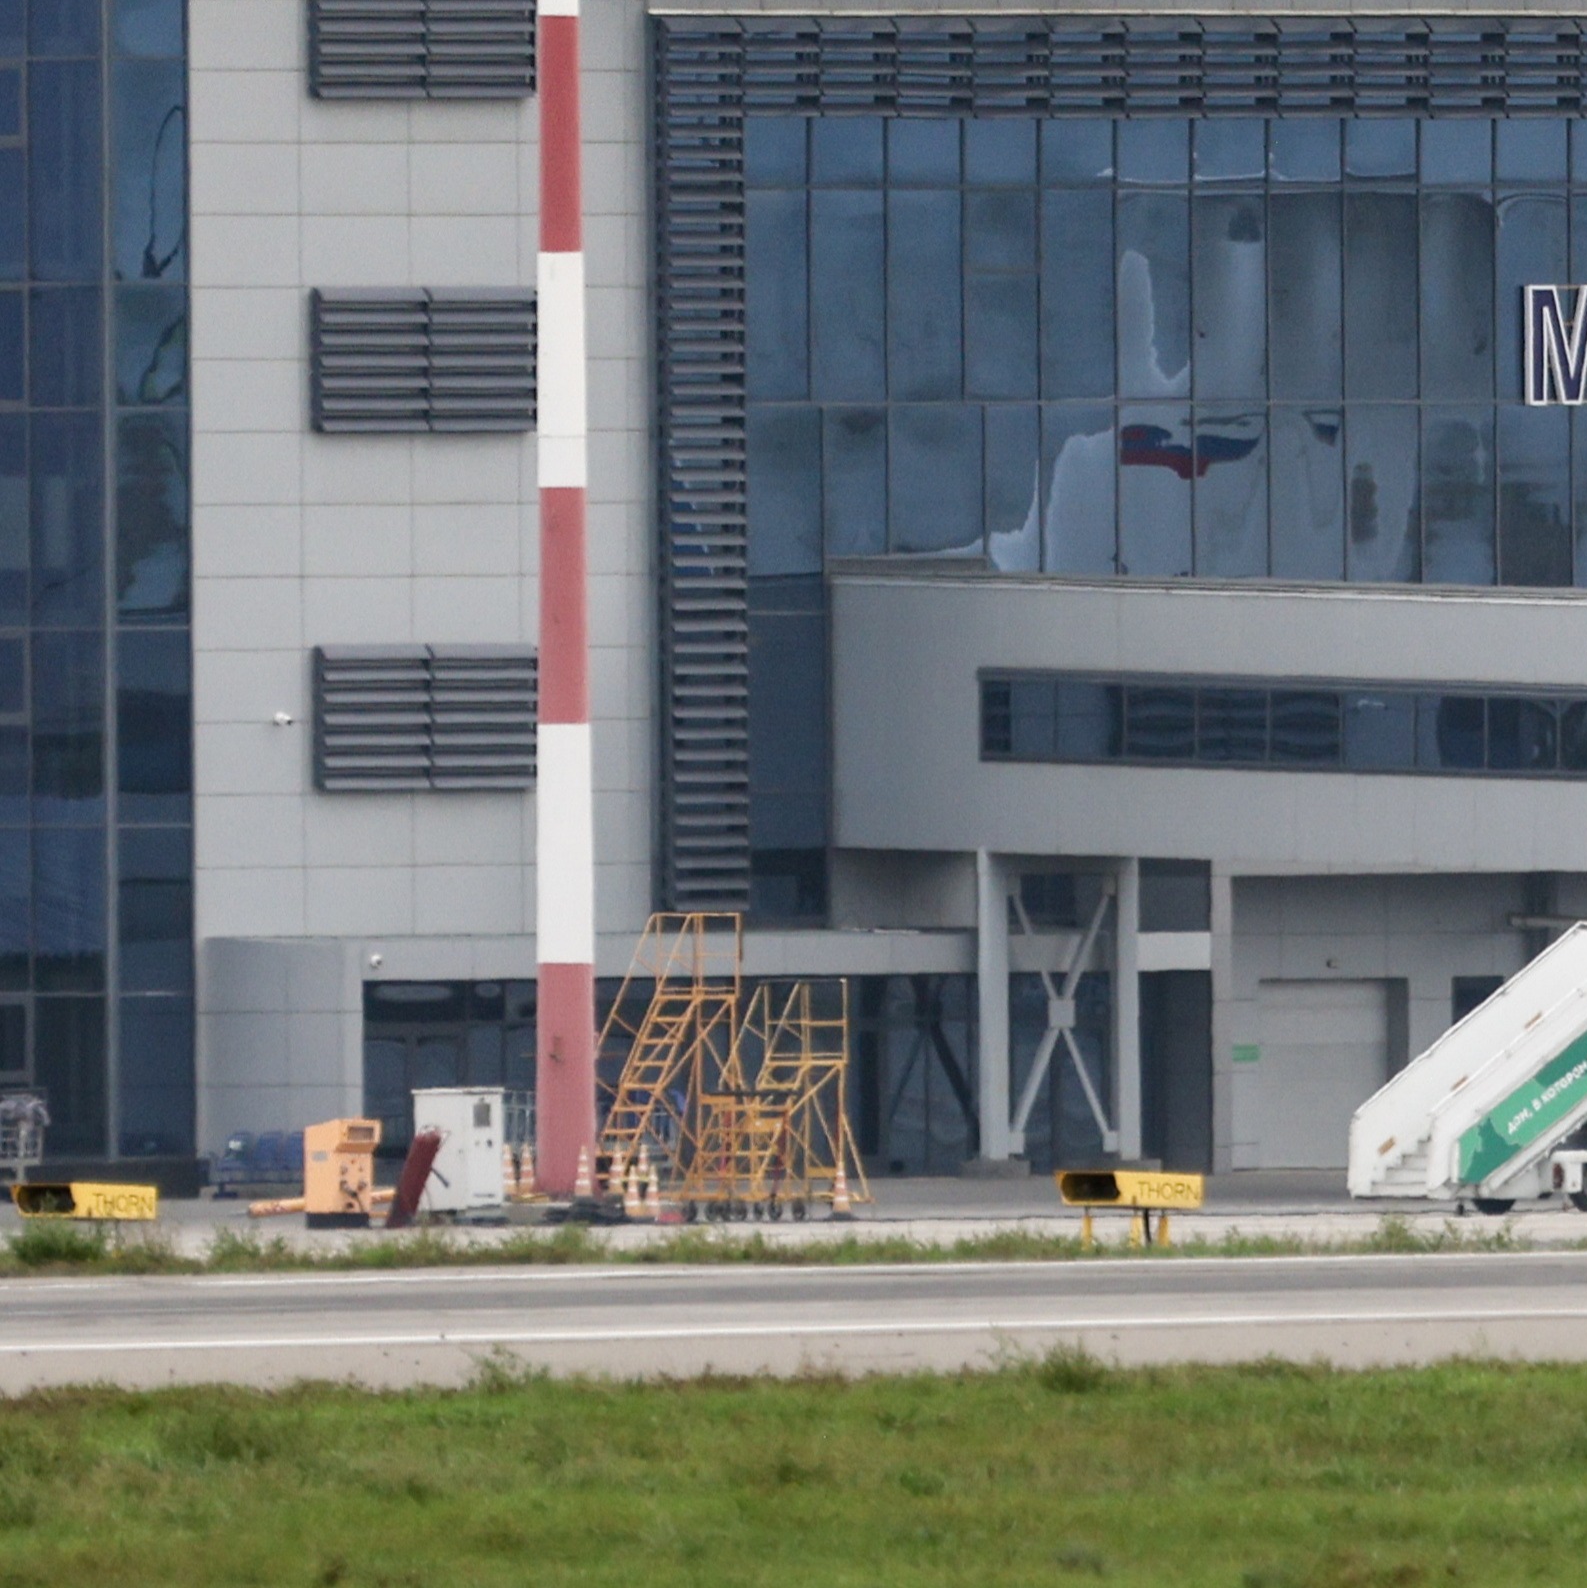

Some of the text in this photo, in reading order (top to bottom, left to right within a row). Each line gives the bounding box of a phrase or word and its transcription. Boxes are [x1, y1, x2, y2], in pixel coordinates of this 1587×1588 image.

[1531, 1098, 1542, 1111] В
[1137, 1181, 1199, 1201] THORN
[92, 1192, 154, 1213] THORN
